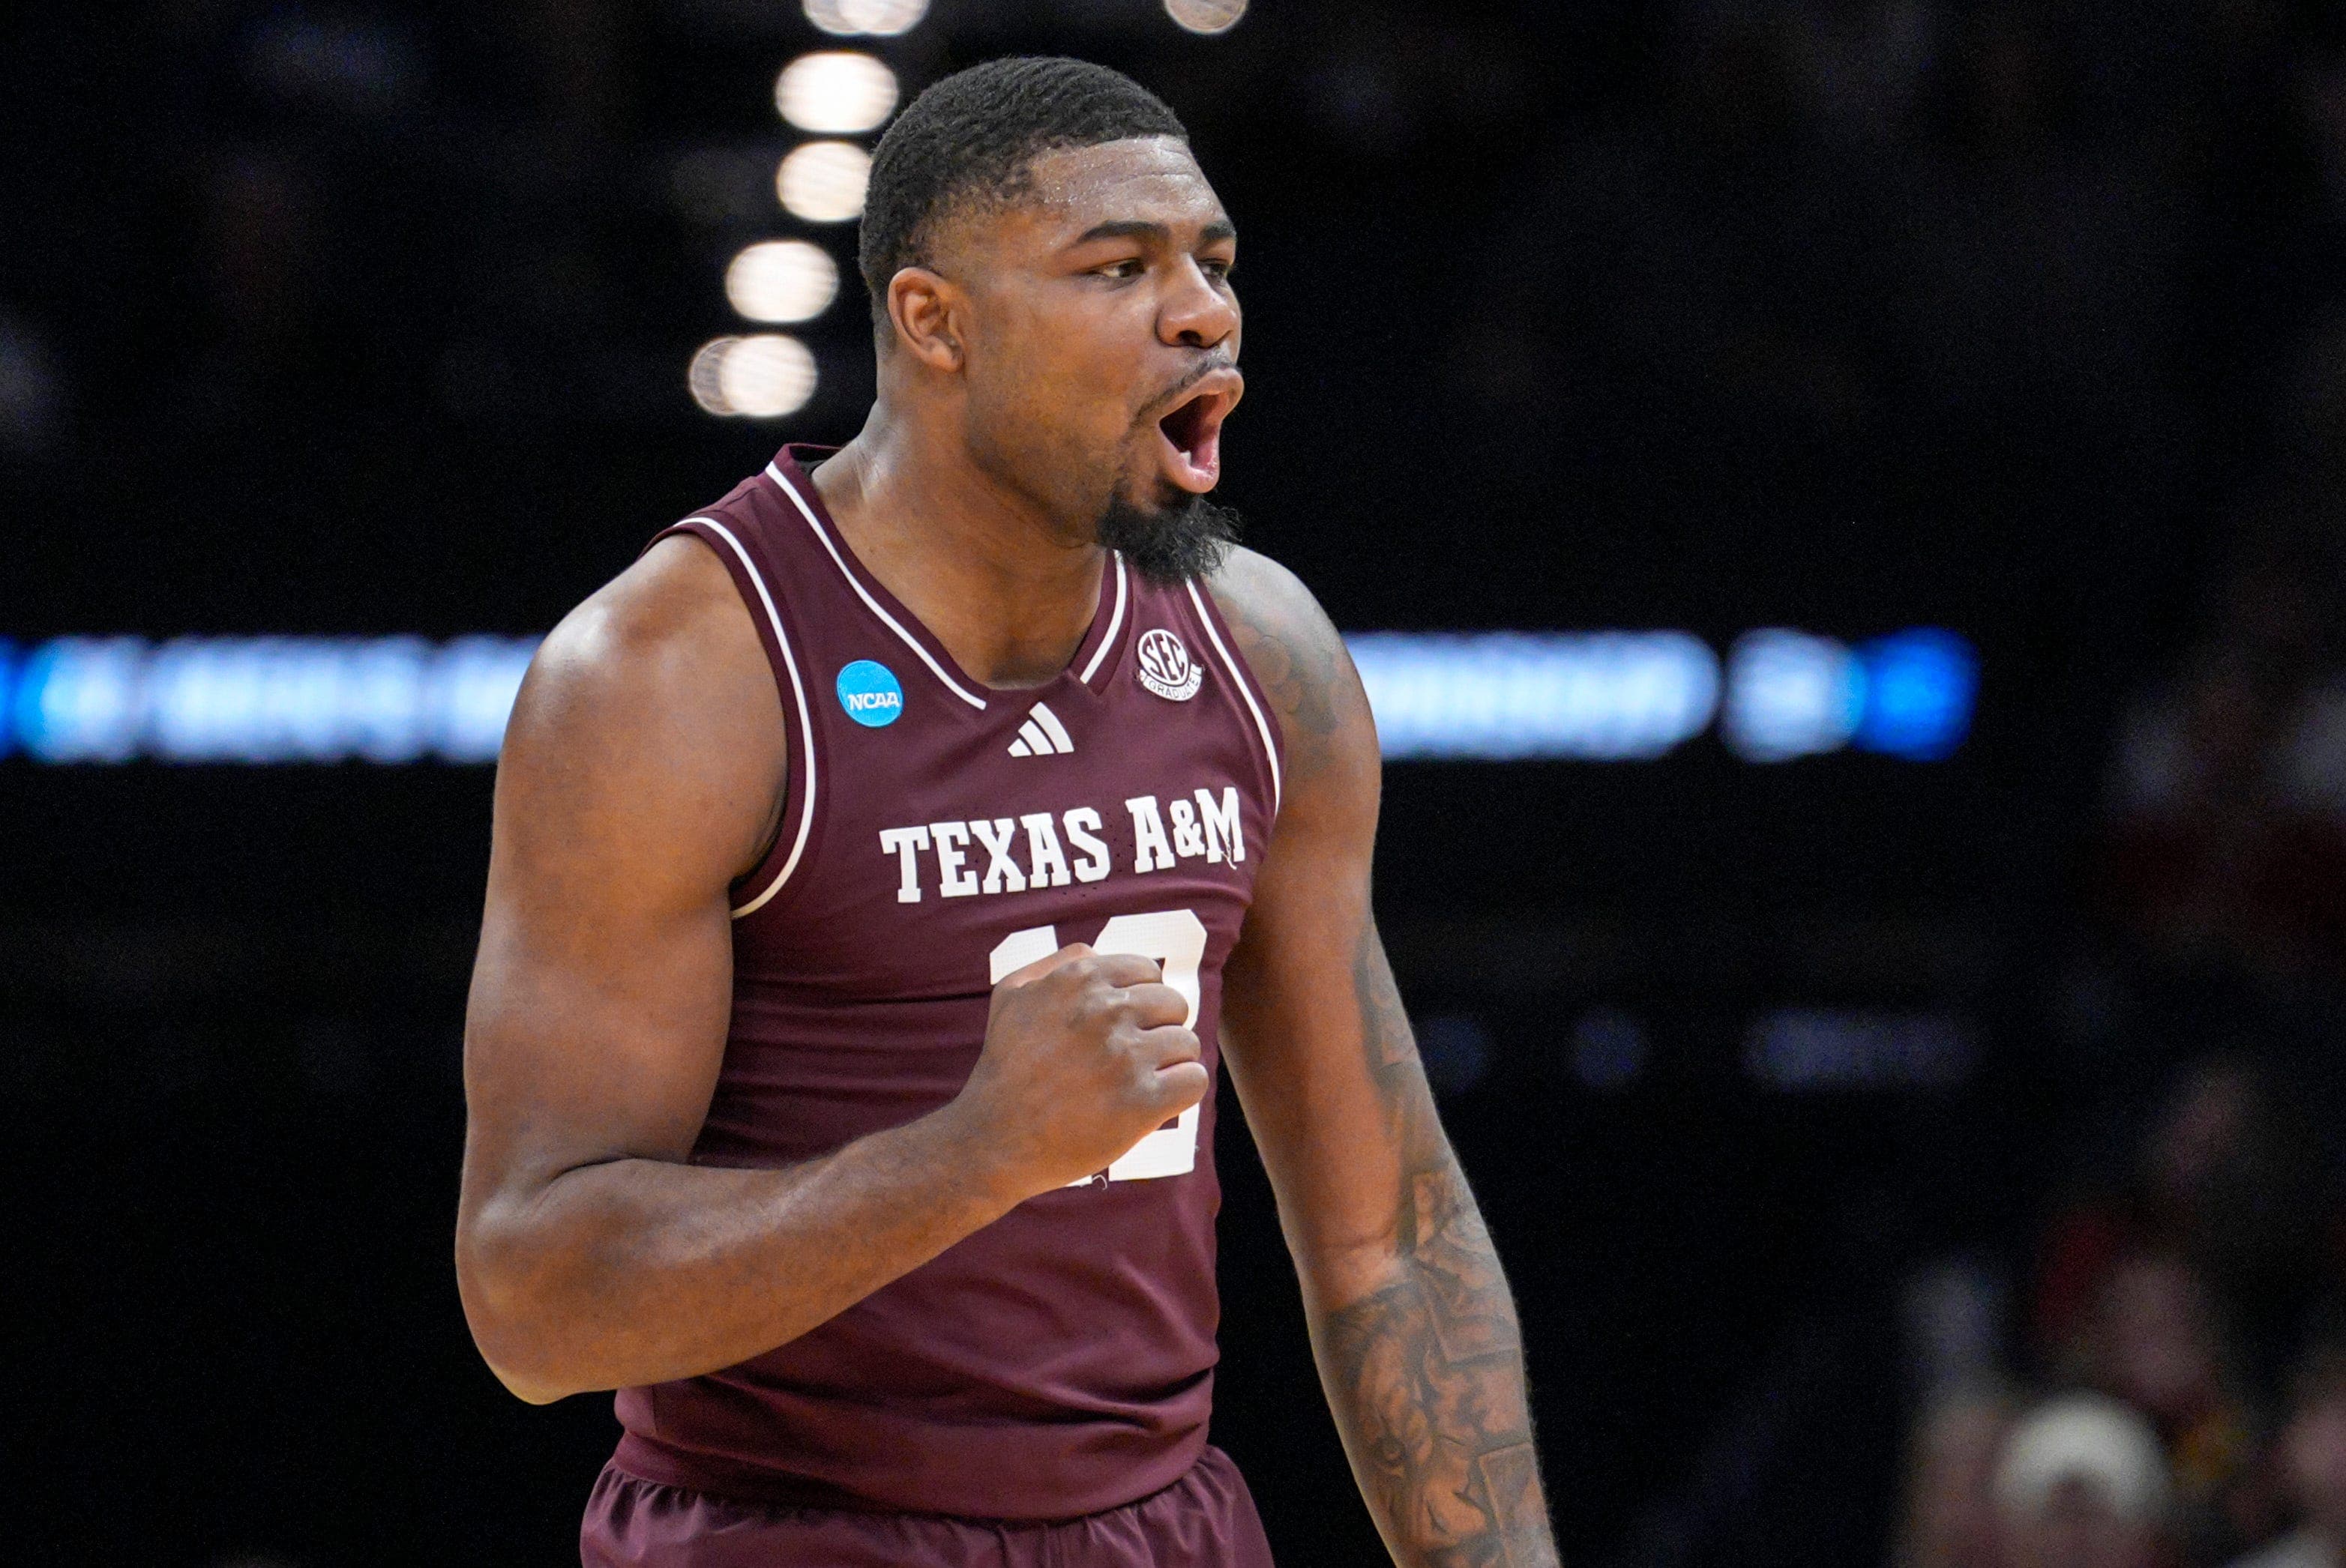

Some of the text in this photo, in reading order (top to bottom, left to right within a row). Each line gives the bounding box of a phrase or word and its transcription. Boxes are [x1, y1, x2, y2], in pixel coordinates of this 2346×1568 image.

[1142, 633, 1185, 681] SEC
[848, 693, 900, 711] NCAA
[1148, 677, 1199, 699] GRADUATE
[879, 787, 1245, 903] TEXAS A&M
